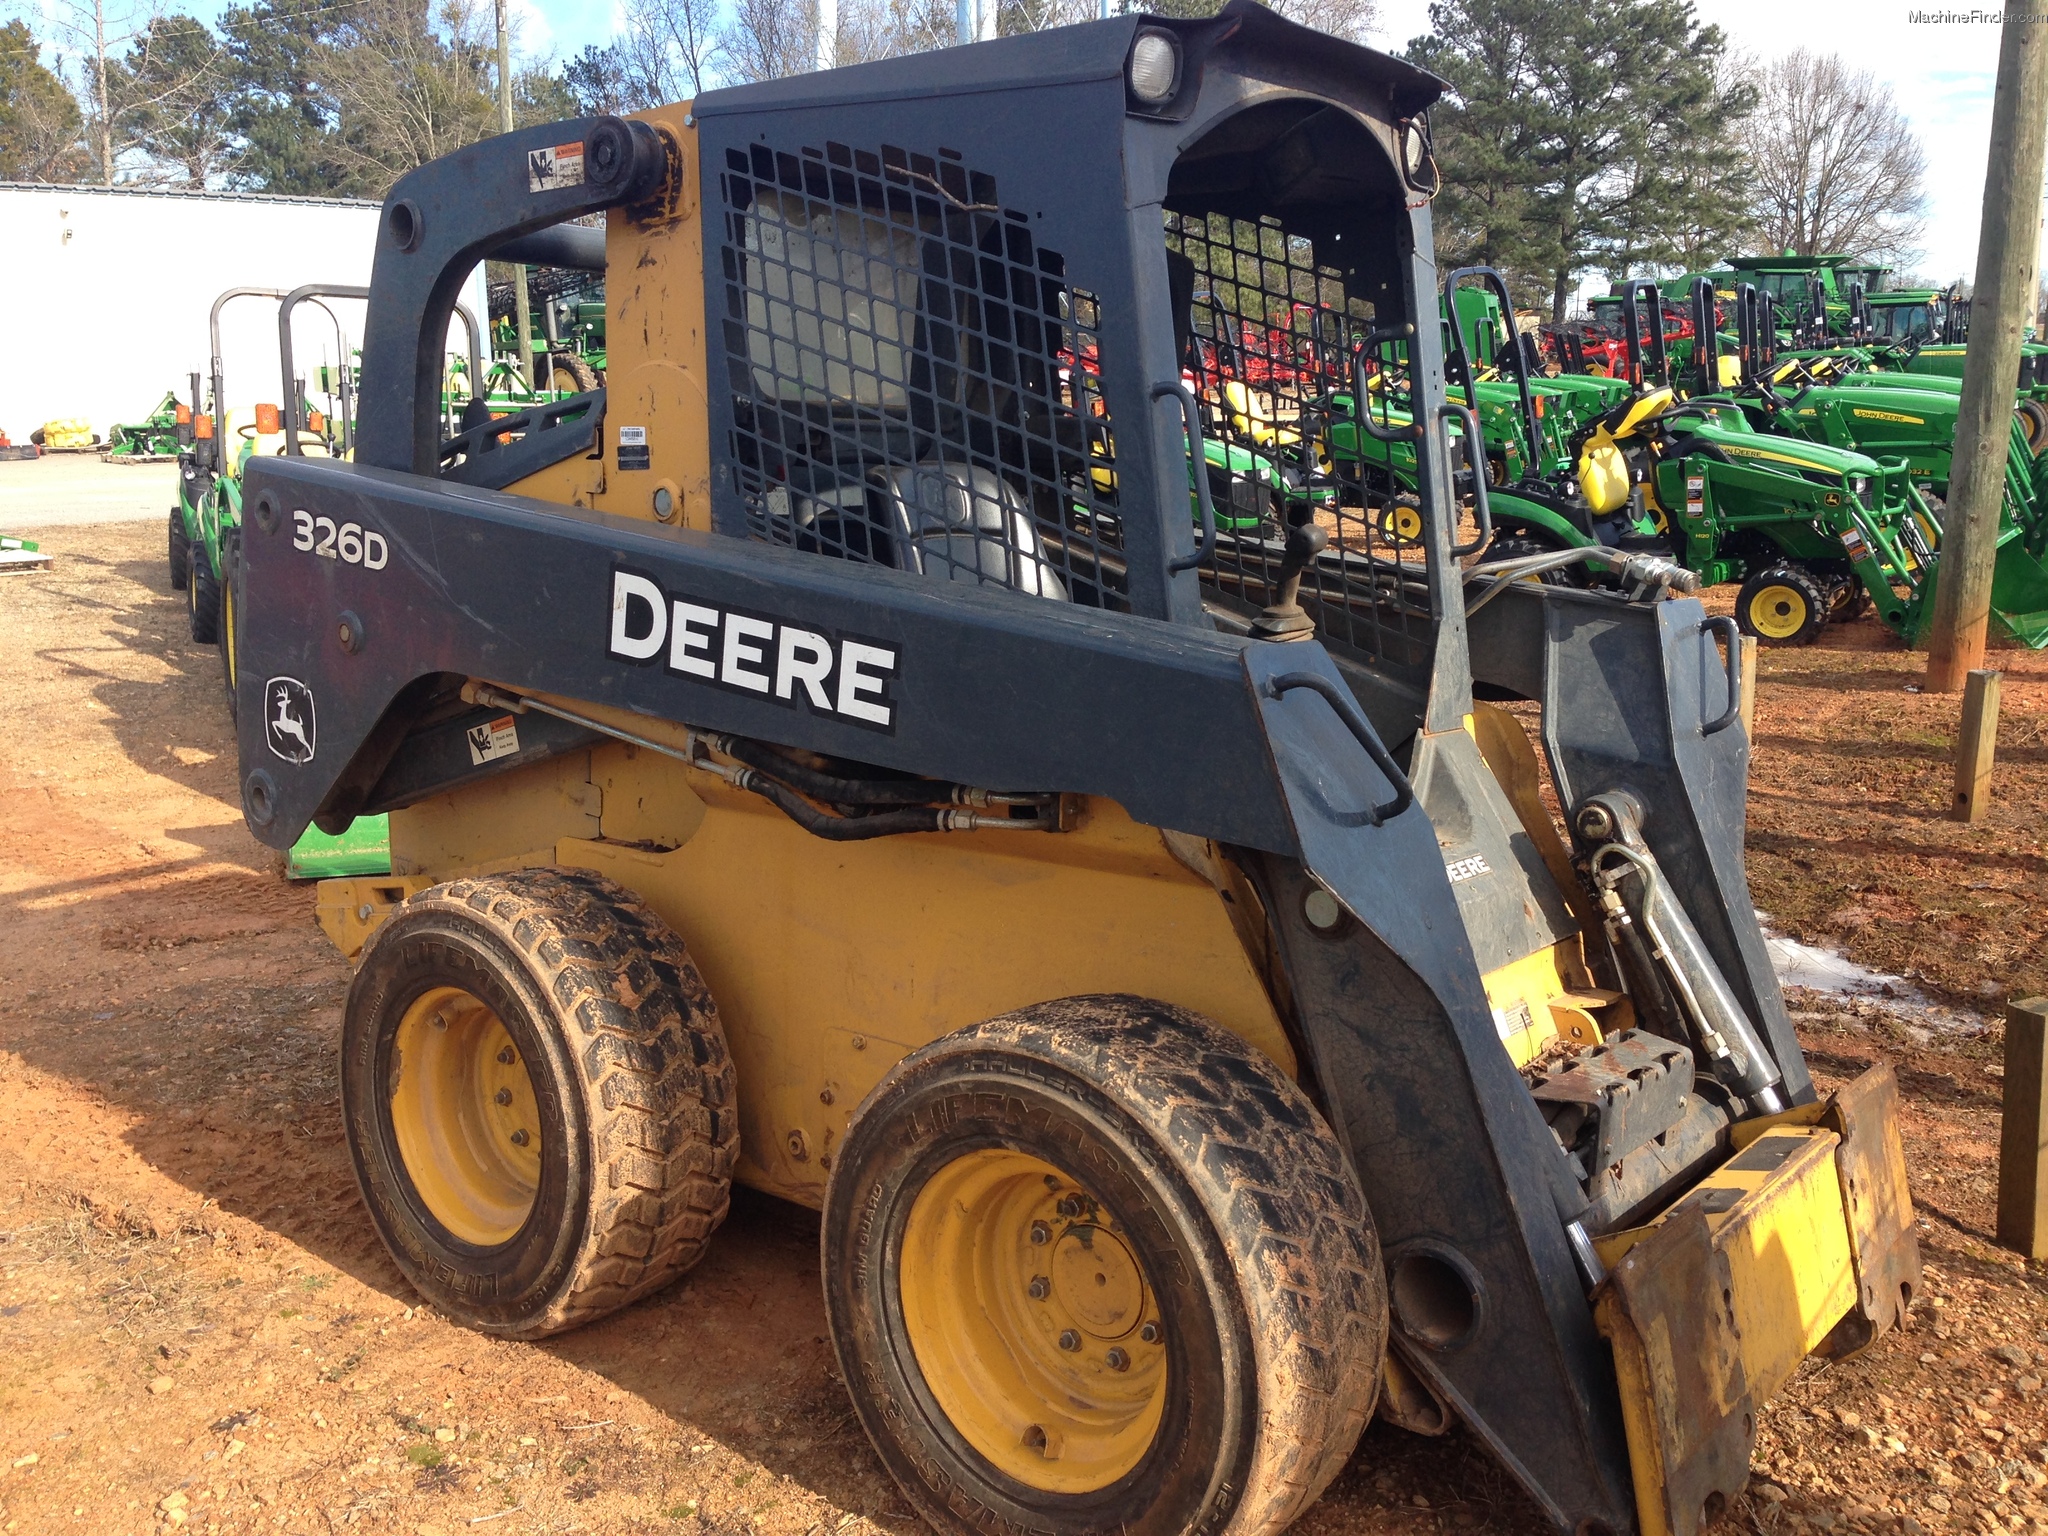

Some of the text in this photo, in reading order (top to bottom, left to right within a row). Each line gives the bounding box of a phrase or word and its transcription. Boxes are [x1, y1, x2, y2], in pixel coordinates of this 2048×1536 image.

[1879, 412, 1905, 421] DEERE
[1734, 448, 1762, 457] DEERE
[293, 509, 389, 571] 326D
[610, 570, 896, 727] DEERE
